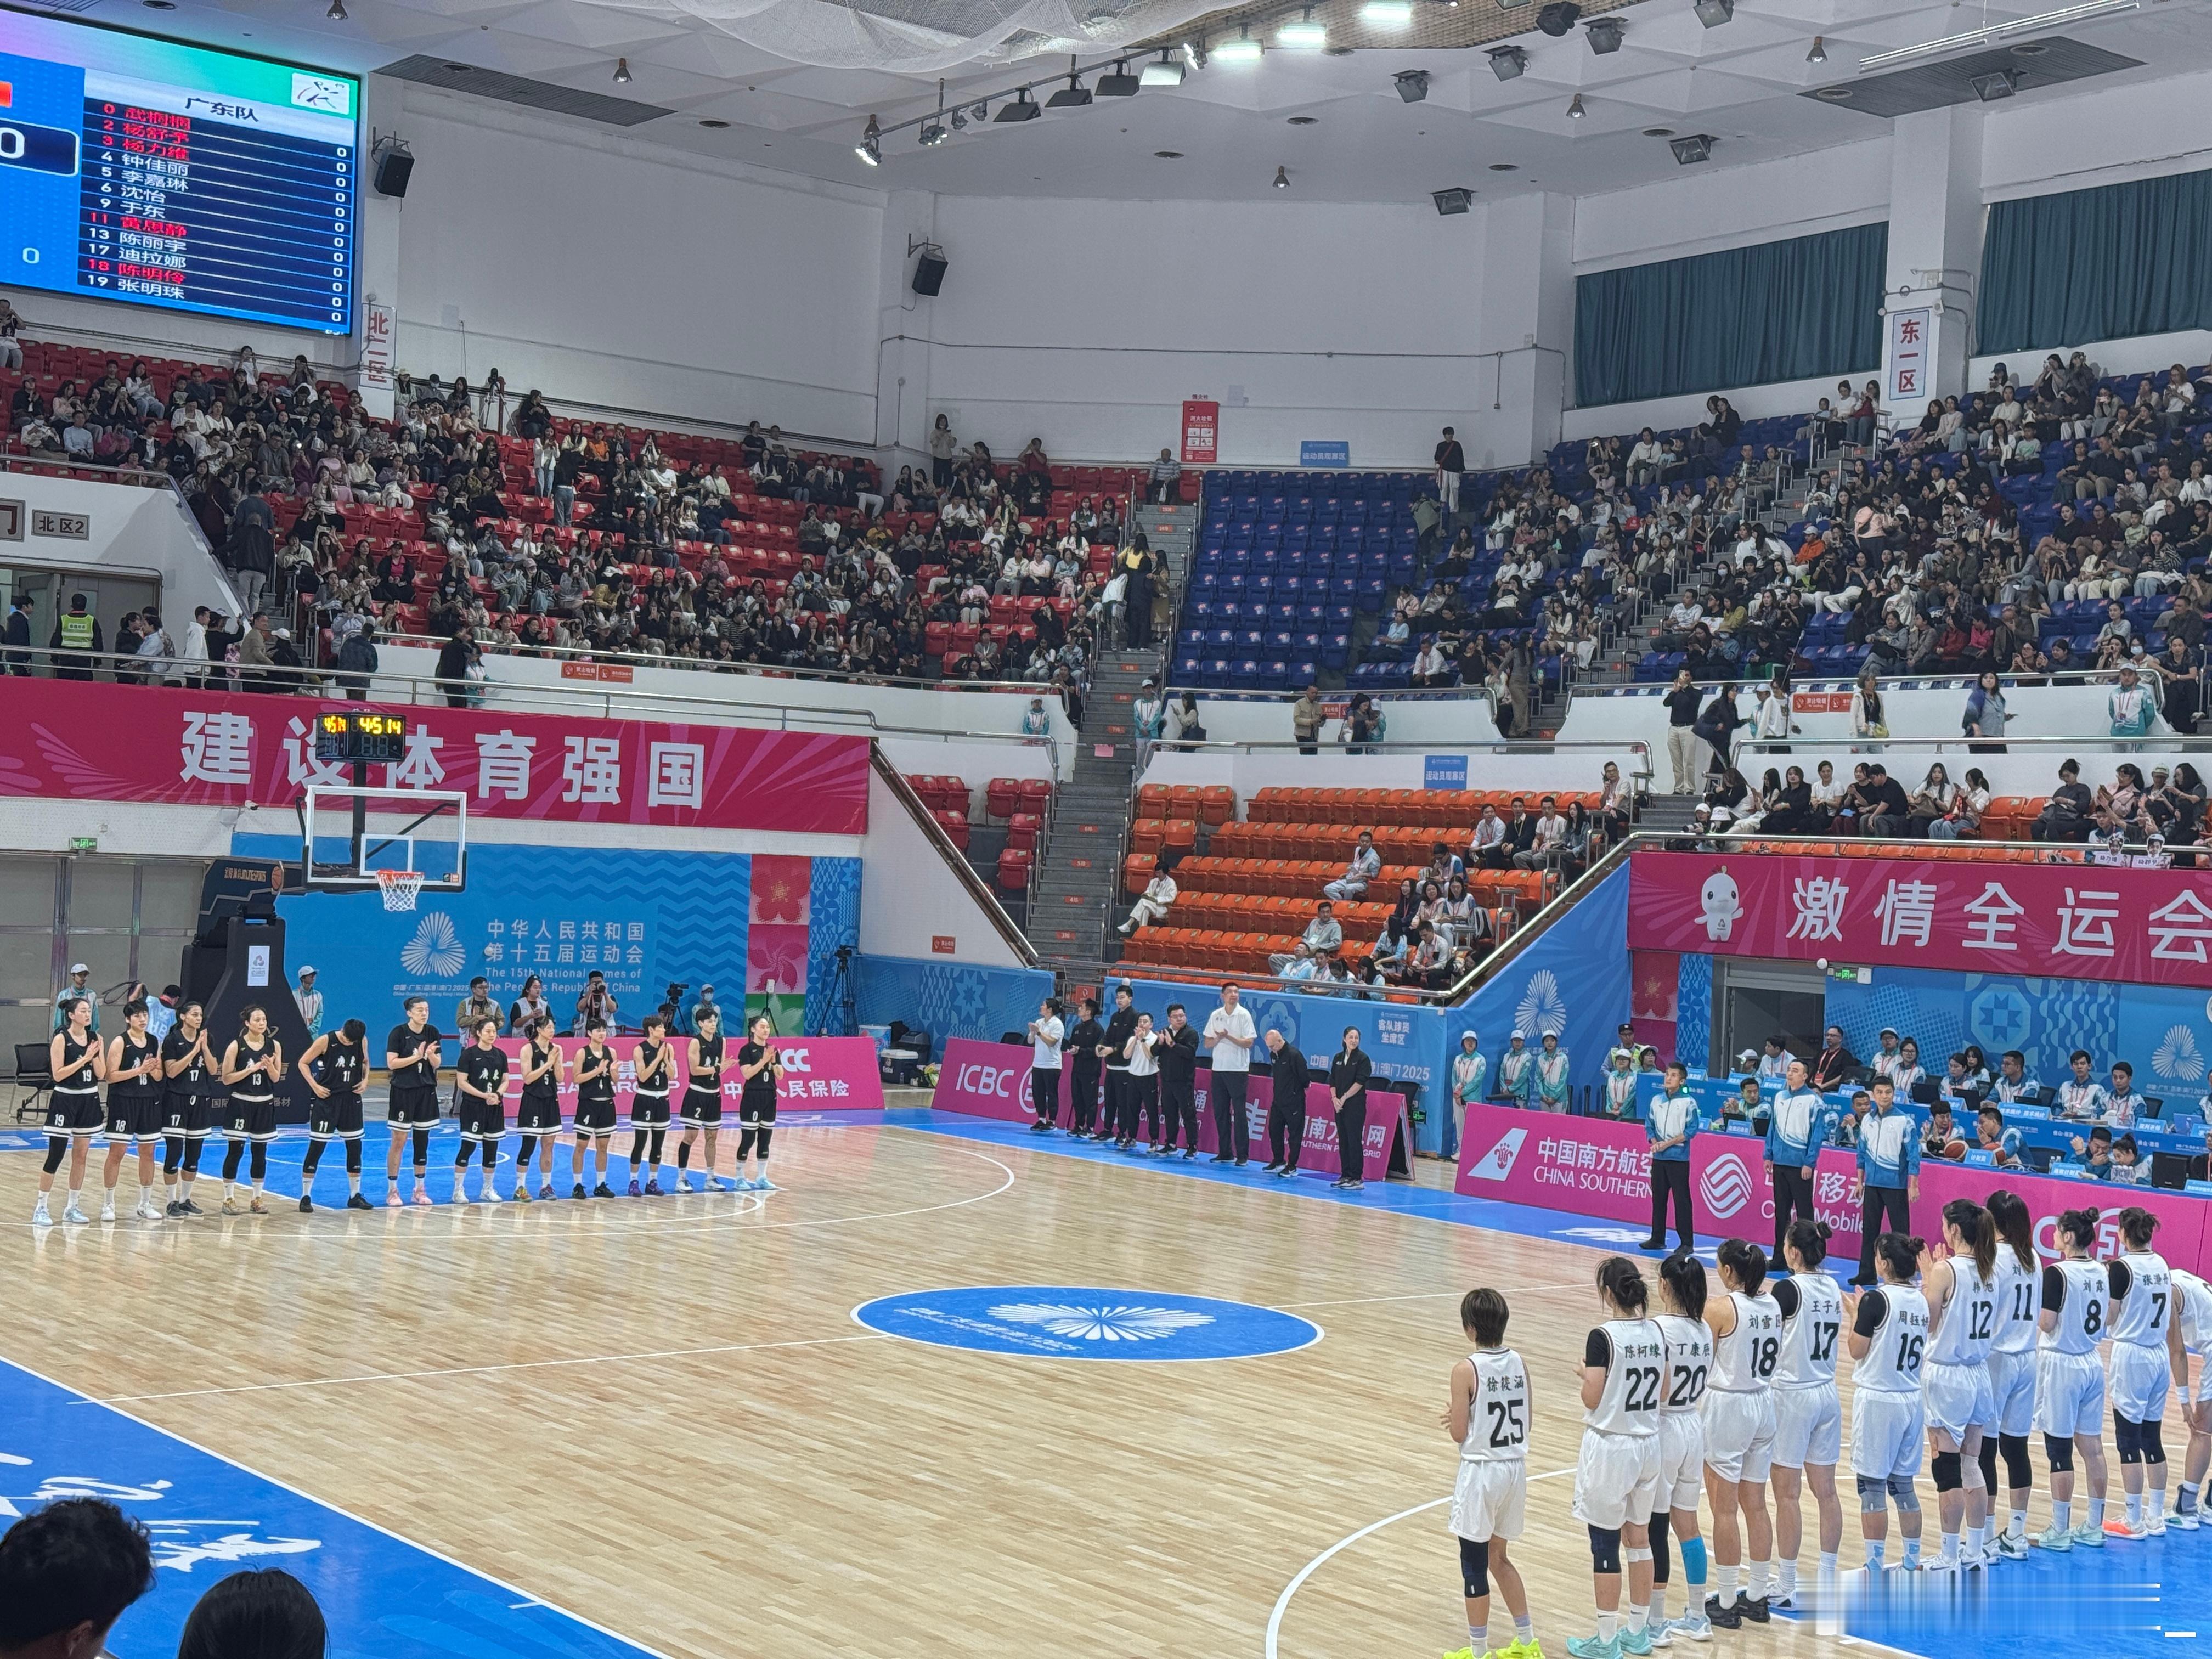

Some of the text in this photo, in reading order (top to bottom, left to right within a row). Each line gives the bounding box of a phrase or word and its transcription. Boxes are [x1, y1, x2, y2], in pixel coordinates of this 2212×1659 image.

[185, 97, 259, 122] 广东队
[103, 103, 116, 115] 0
[337, 148, 347, 157] 0
[0, 127, 25, 159] 0
[103, 119, 114, 131] 2
[336, 162, 346, 173] 0
[102, 134, 114, 146] 3
[335, 177, 346, 188] 0
[101, 151, 346, 203] 4 钟佳丽 0
[101, 166, 345, 217] 5 李嘉琳 0
[101, 182, 345, 232] 6 沈怡 0
[100, 198, 344, 247] 9 于东 0
[90, 212, 108, 224] 11
[334, 252, 343, 262] 0
[22, 247, 40, 264] 0
[89, 228, 343, 278] 13 陈丽宇 0
[88, 243, 342, 292] 17 迪拉娜 0
[88, 258, 110, 272] 18
[332, 297, 342, 307] 0
[87, 274, 341, 322] 19 张明珠 0
[1898, 318, 1921, 393] 东一区
[38, 515, 84, 534] 北区2
[179, 710, 705, 810] 建设体育强国
[487, 918, 645, 941] 中华人民共和国
[1786, 876, 2212, 963] 激情全运会
[486, 941, 644, 964] 第十五届运动会
[485, 967, 505, 977] The
[511, 968, 535, 977] 15th
[539, 968, 586, 978] National
[631, 969, 642, 978] of
[488, 981, 501, 991] he
[612, 983, 641, 992] China
[1378, 1018, 1410, 1034] 客队球员
[1380, 1032, 1406, 1045] 坐席区
[83, 1070, 92, 1082] 19
[139, 1074, 148, 1085] 18
[190, 1070, 199, 1082] 17
[343, 1070, 351, 1082] 11
[418, 1062, 423, 1074] 9
[763, 1071, 769, 1082] 0
[1402, 1065, 1431, 1081] 2025
[253, 1074, 262, 1086] 13
[544, 1074, 549, 1086] 5
[599, 1079, 603, 1090] 4
[654, 1075, 659, 1086] 3
[723, 1079, 850, 1100] 中民保险
[956, 1063, 1015, 1098] ICBC
[55, 1114, 65, 1126] 19
[171, 1114, 181, 1126] 17
[235, 1118, 245, 1130] 13
[398, 1111, 405, 1122] 9
[532, 1116, 539, 1127] 5
[583, 1114, 589, 1125] 4
[645, 1110, 651, 1121] 3
[694, 1107, 702, 1118] 2
[752, 1110, 758, 1121] 0
[116, 1119, 126, 1132] 18
[319, 1120, 329, 1132] 11
[472, 1121, 479, 1132] 6
[1363, 1149, 1381, 1159] GRID
[1538, 1136, 1653, 1177] 中国南方航空
[1534, 1165, 1653, 1198] CHINA SOUTHERN
[2012, 1283, 2033, 1321] 11
[2150, 1292, 2166, 1329] 7
[1968, 1301, 1993, 1340] 12
[2084, 1299, 2102, 1335] 8
[1810, 1321, 1839, 1361] 17
[1896, 1333, 1925, 1372] 16
[1751, 1337, 1779, 1379] 18
[1624, 1367, 1660, 1413] 22
[1668, 1365, 1707, 1407] 20
[1487, 1398, 1524, 1448] 25
